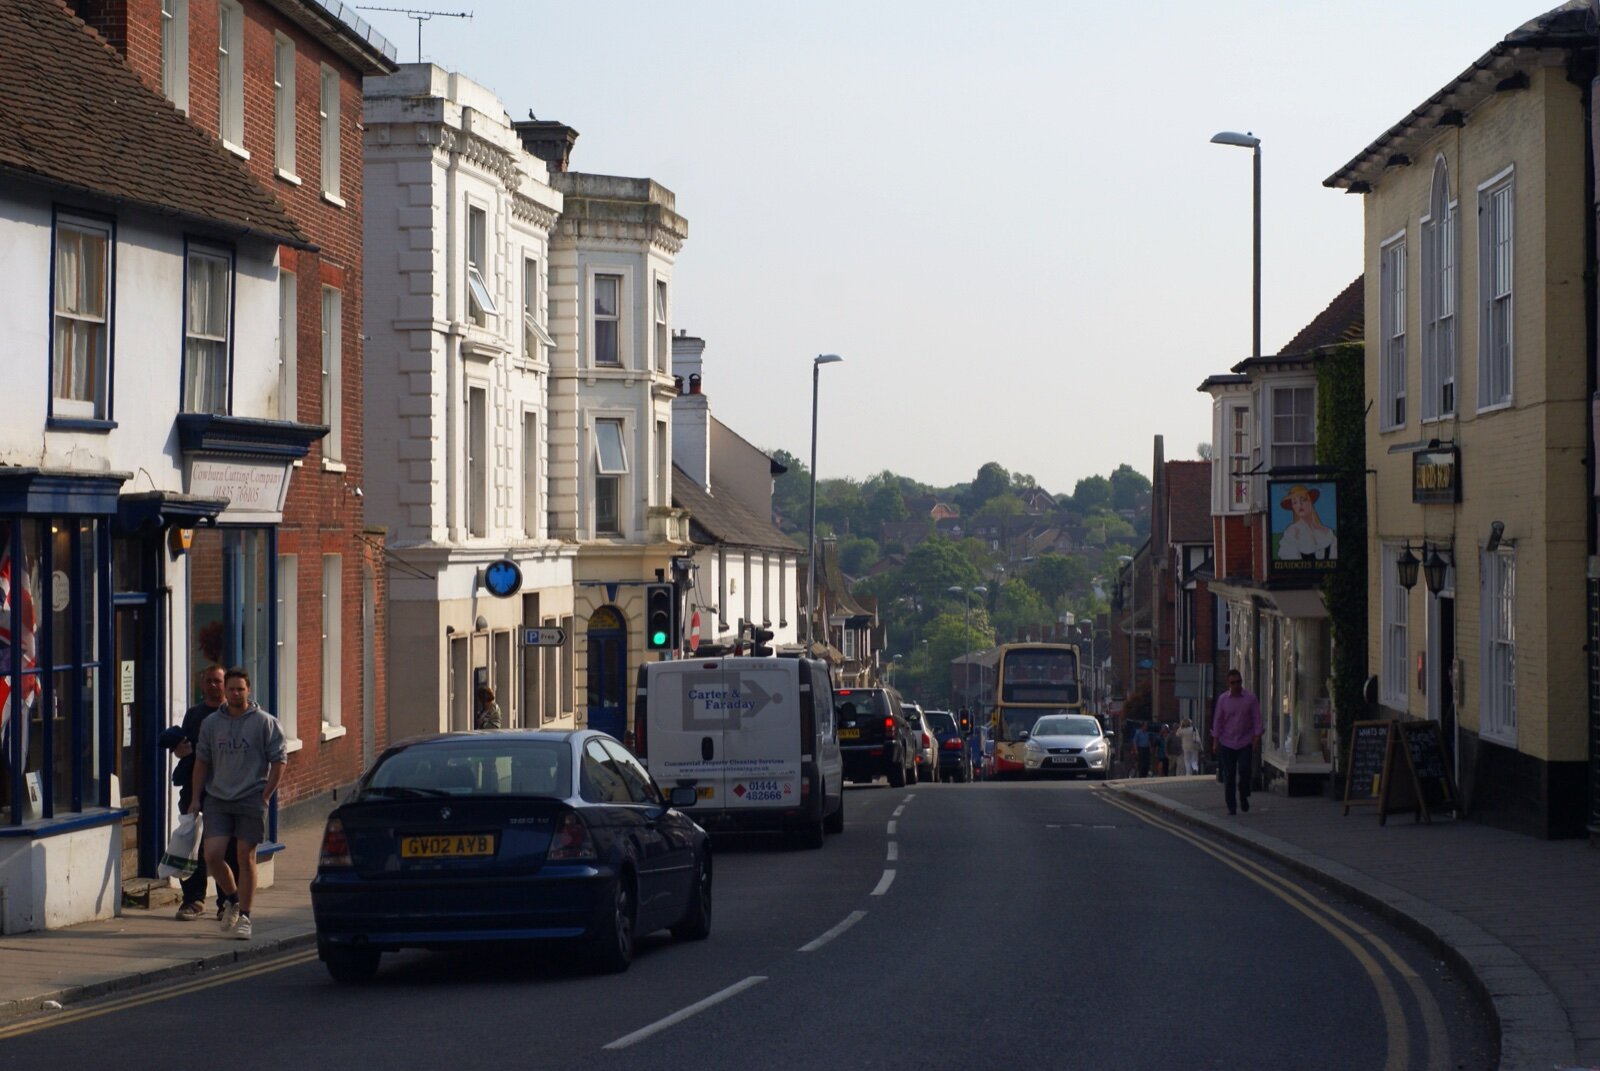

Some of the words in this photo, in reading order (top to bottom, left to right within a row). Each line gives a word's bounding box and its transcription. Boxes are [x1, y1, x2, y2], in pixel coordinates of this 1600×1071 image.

[193, 463, 224, 481] Cowburn
[224, 465, 250, 484] Cutting
[250, 467, 282, 488] Company
[529, 632, 538, 643] P
[688, 689, 728, 700] Carter
[731, 689, 741, 699] &
[705, 699, 756, 710] Faraday
[217, 738, 250, 749] FILA
[749, 781, 778, 791] 01444
[746, 790, 782, 801] 482666
[408, 838, 450, 854] GV02
[456, 836, 487, 853] AYB
